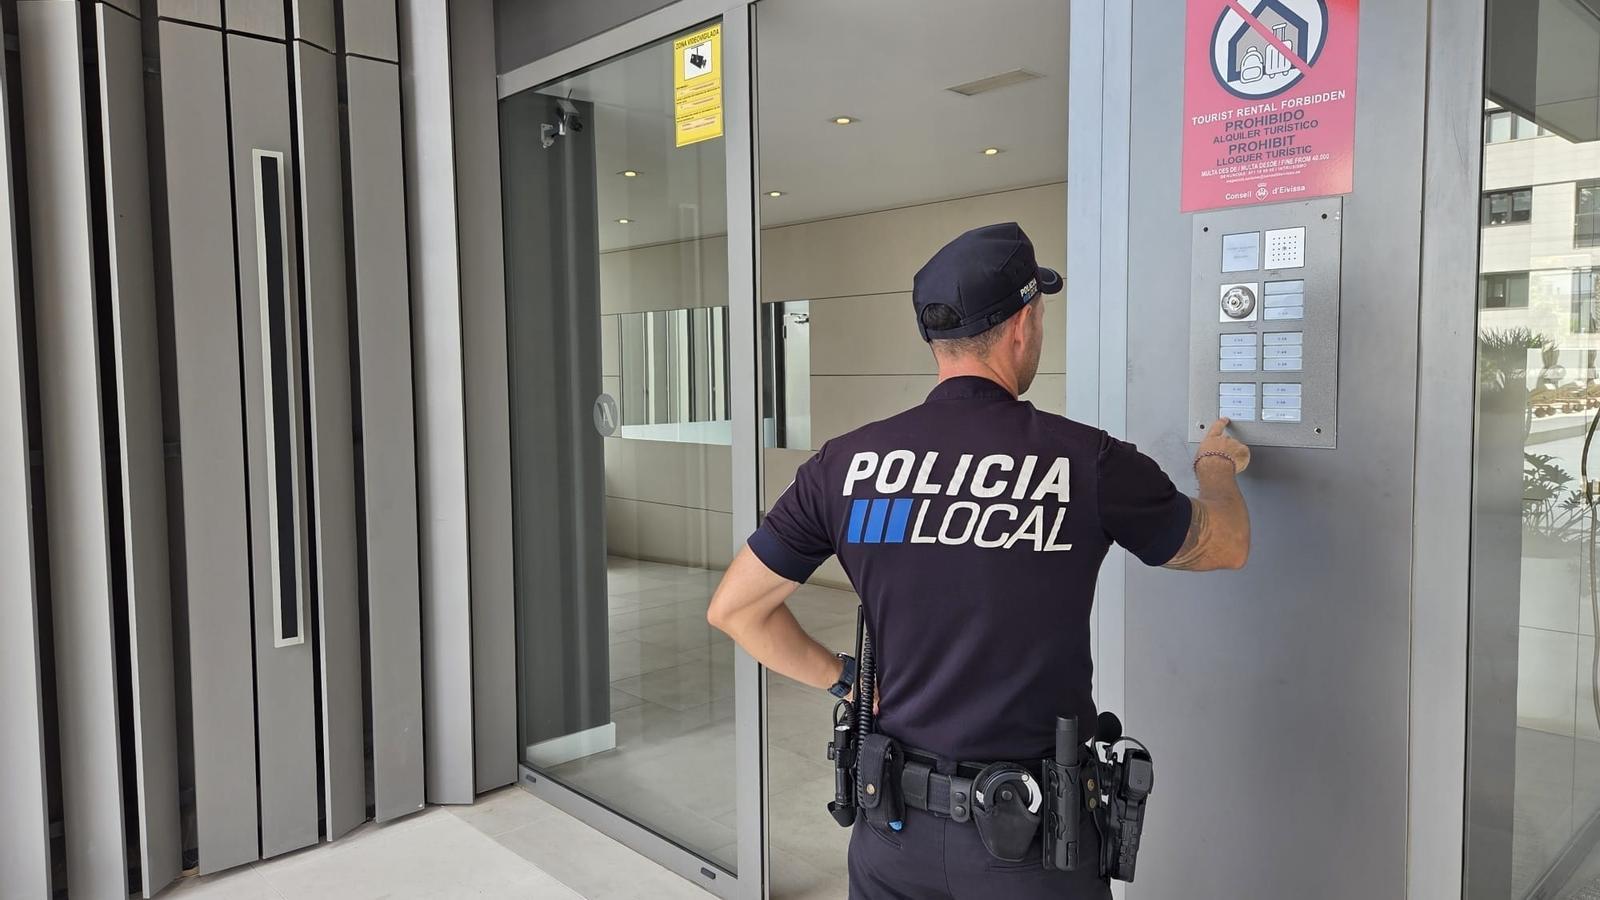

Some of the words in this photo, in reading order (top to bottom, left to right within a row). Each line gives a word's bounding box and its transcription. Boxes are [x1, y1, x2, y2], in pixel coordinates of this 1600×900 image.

[1191, 109, 1233, 126] TOURIST
[1236, 101, 1278, 118] RENTAL
[1281, 89, 1346, 109] FORBIDDEN
[1213, 129, 1261, 144] ALQUILER
[1264, 119, 1319, 136] TURÍSTICO
[1225, 109, 1304, 132] PROHIBIDO
[1216, 152, 1263, 166] LLOGUER
[1266, 144, 1312, 159] TURÍSTIC
[1228, 134, 1296, 155] PROHIBIT
[1225, 191, 1252, 200] Consell
[1272, 185, 1306, 195] d'Eivissa
[843, 449, 1070, 502] POLICIA
[910, 499, 1073, 551] LOCAL
